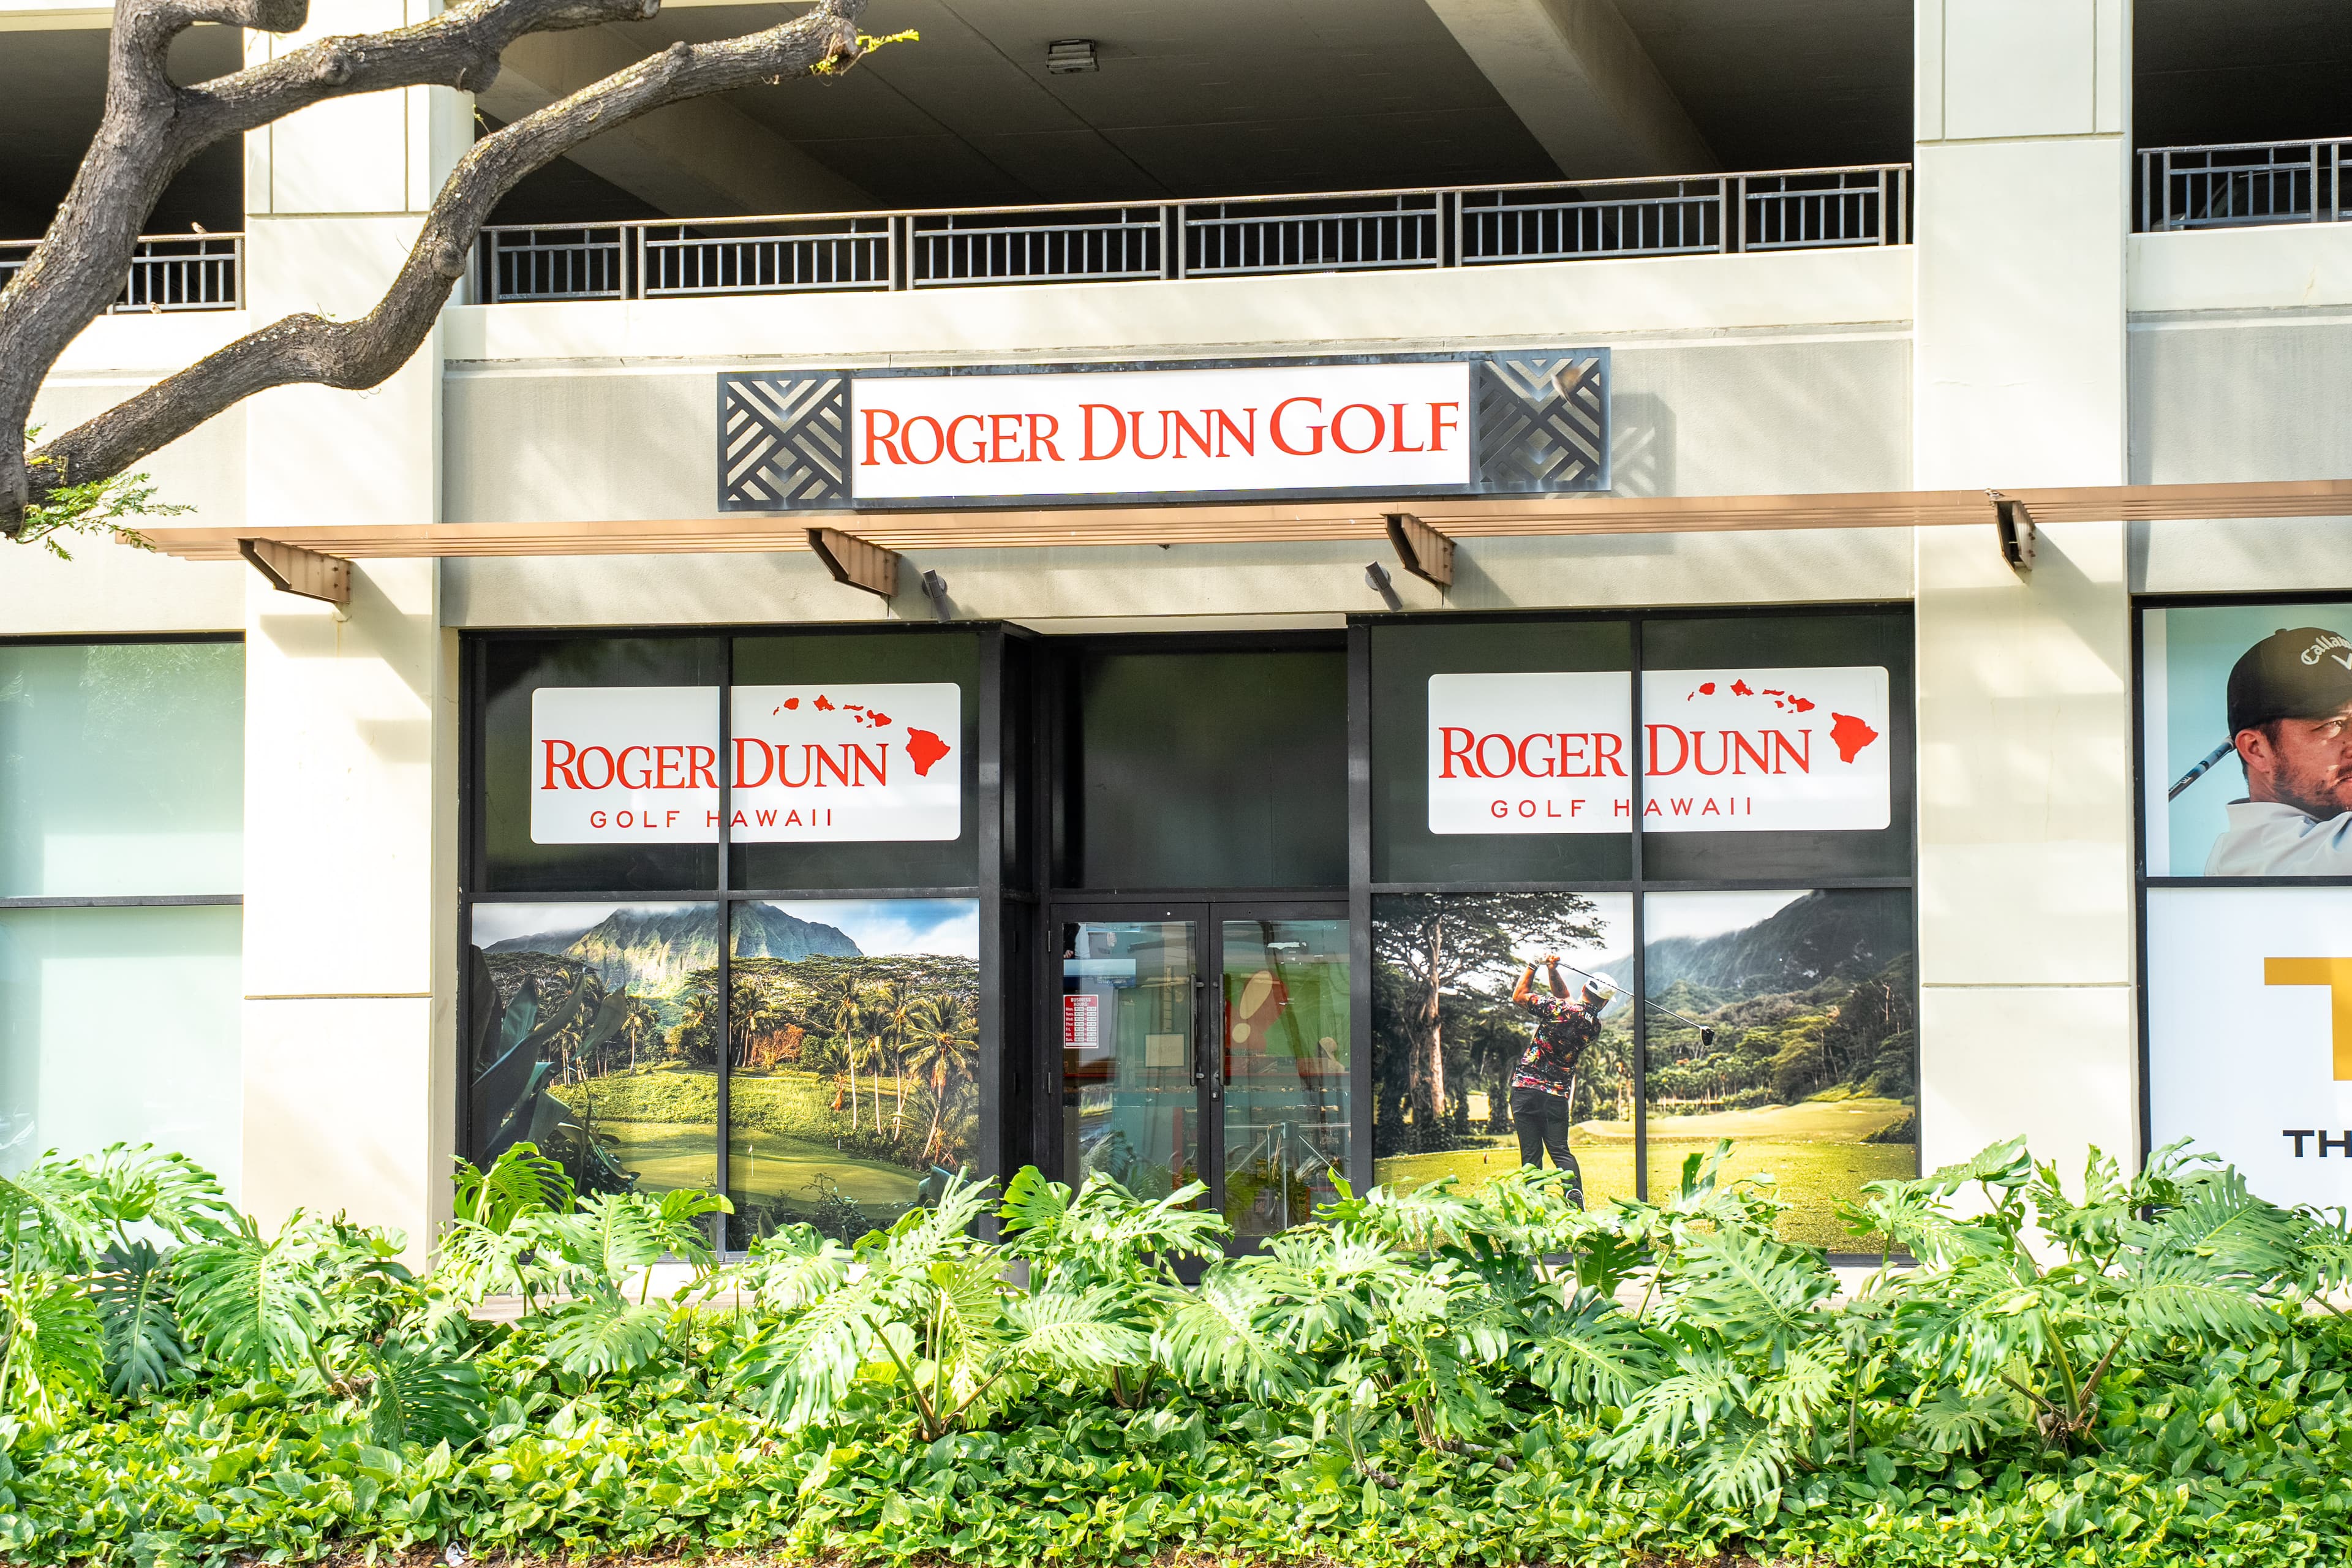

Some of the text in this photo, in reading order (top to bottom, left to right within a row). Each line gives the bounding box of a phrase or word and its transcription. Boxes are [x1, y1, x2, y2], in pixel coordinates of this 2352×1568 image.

[861, 397, 1459, 466] ROGER DUNN GOLF
[542, 738, 889, 790] ROGER DUNN
[1439, 725, 1812, 778] ROGER DUNN
[590, 809, 831, 829] GOLF HAWAII
[1491, 797, 1751, 818] GOLF HAWAII
